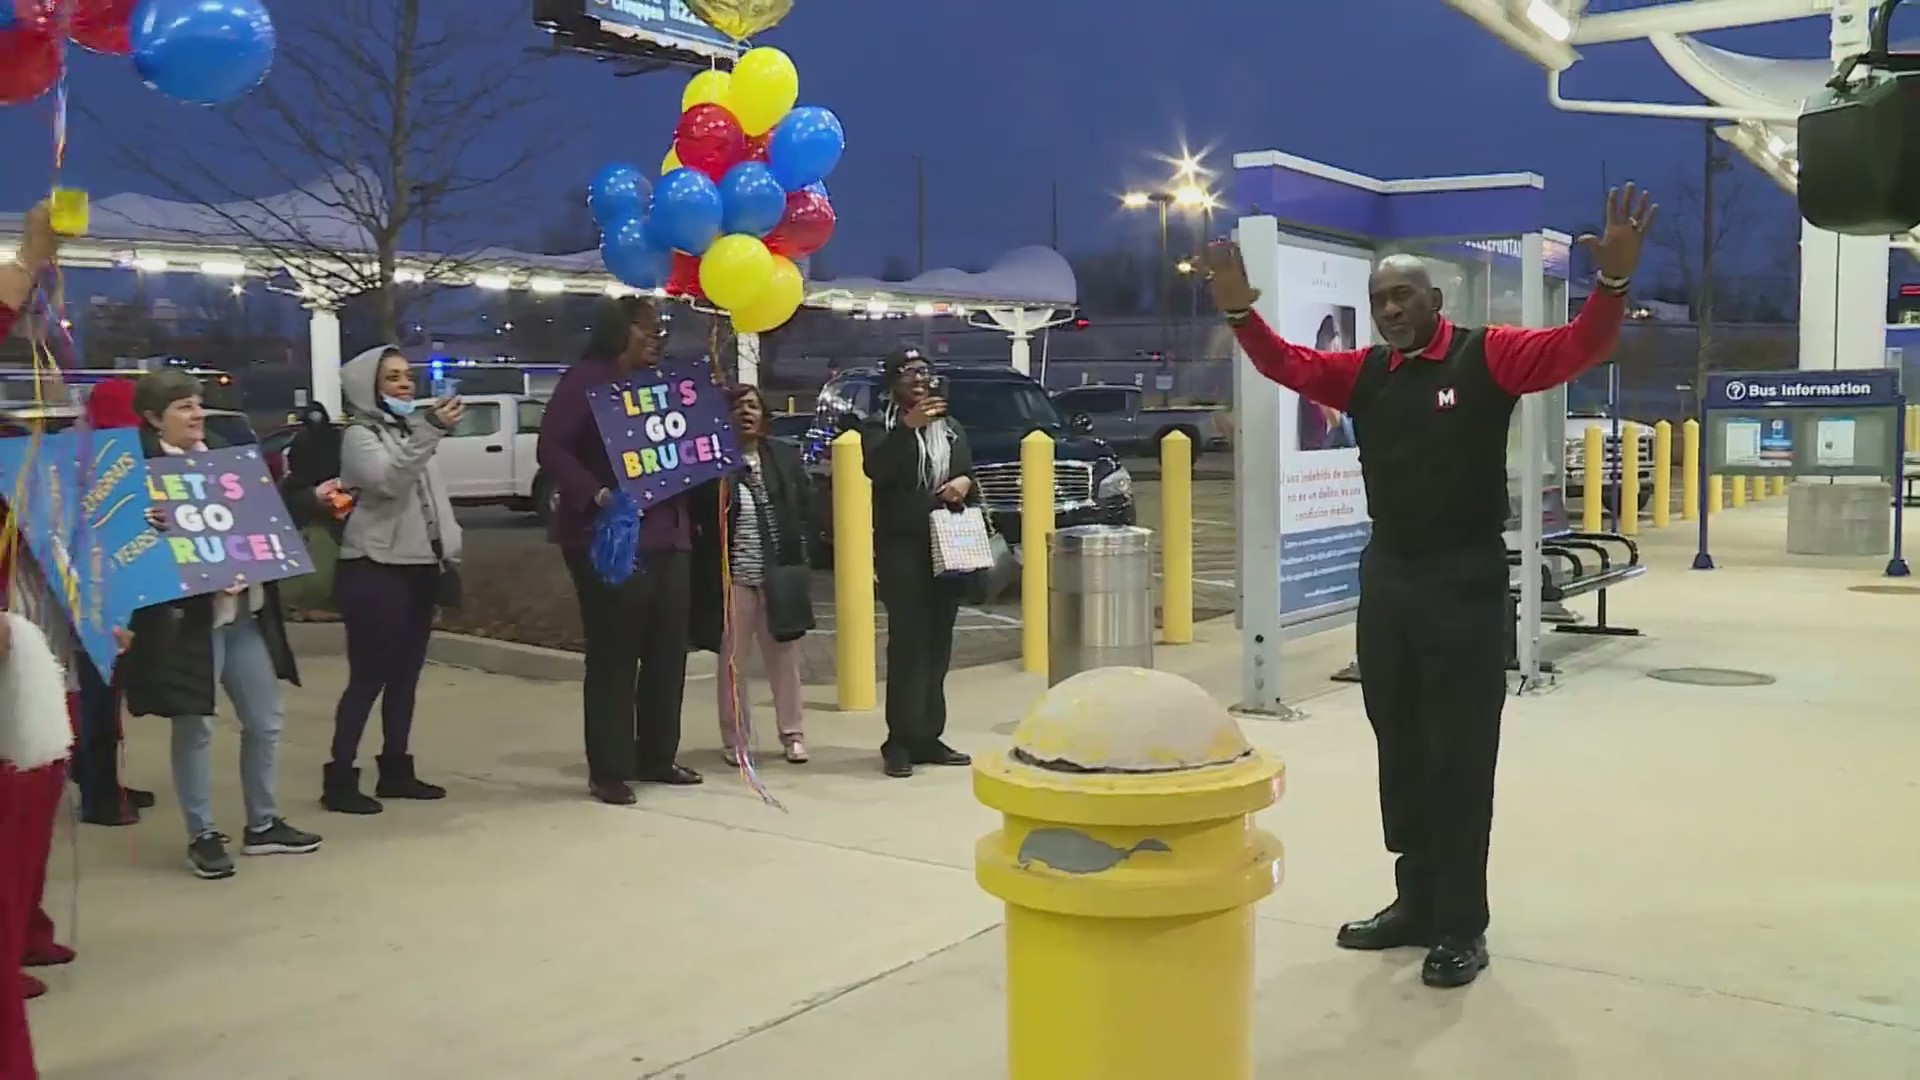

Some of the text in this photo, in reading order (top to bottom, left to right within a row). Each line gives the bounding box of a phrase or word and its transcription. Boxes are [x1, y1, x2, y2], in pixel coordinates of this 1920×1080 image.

[622, 379, 698, 417] LET'S
[1438, 388, 1455, 407] M
[1749, 381, 1871, 397] Bus Information
[645, 410, 687, 443] GO
[622, 433, 722, 479] BRUCE!
[146, 472, 244, 503] LET'S
[174, 502, 234, 533] GO
[167, 532, 286, 565] RUCE!
